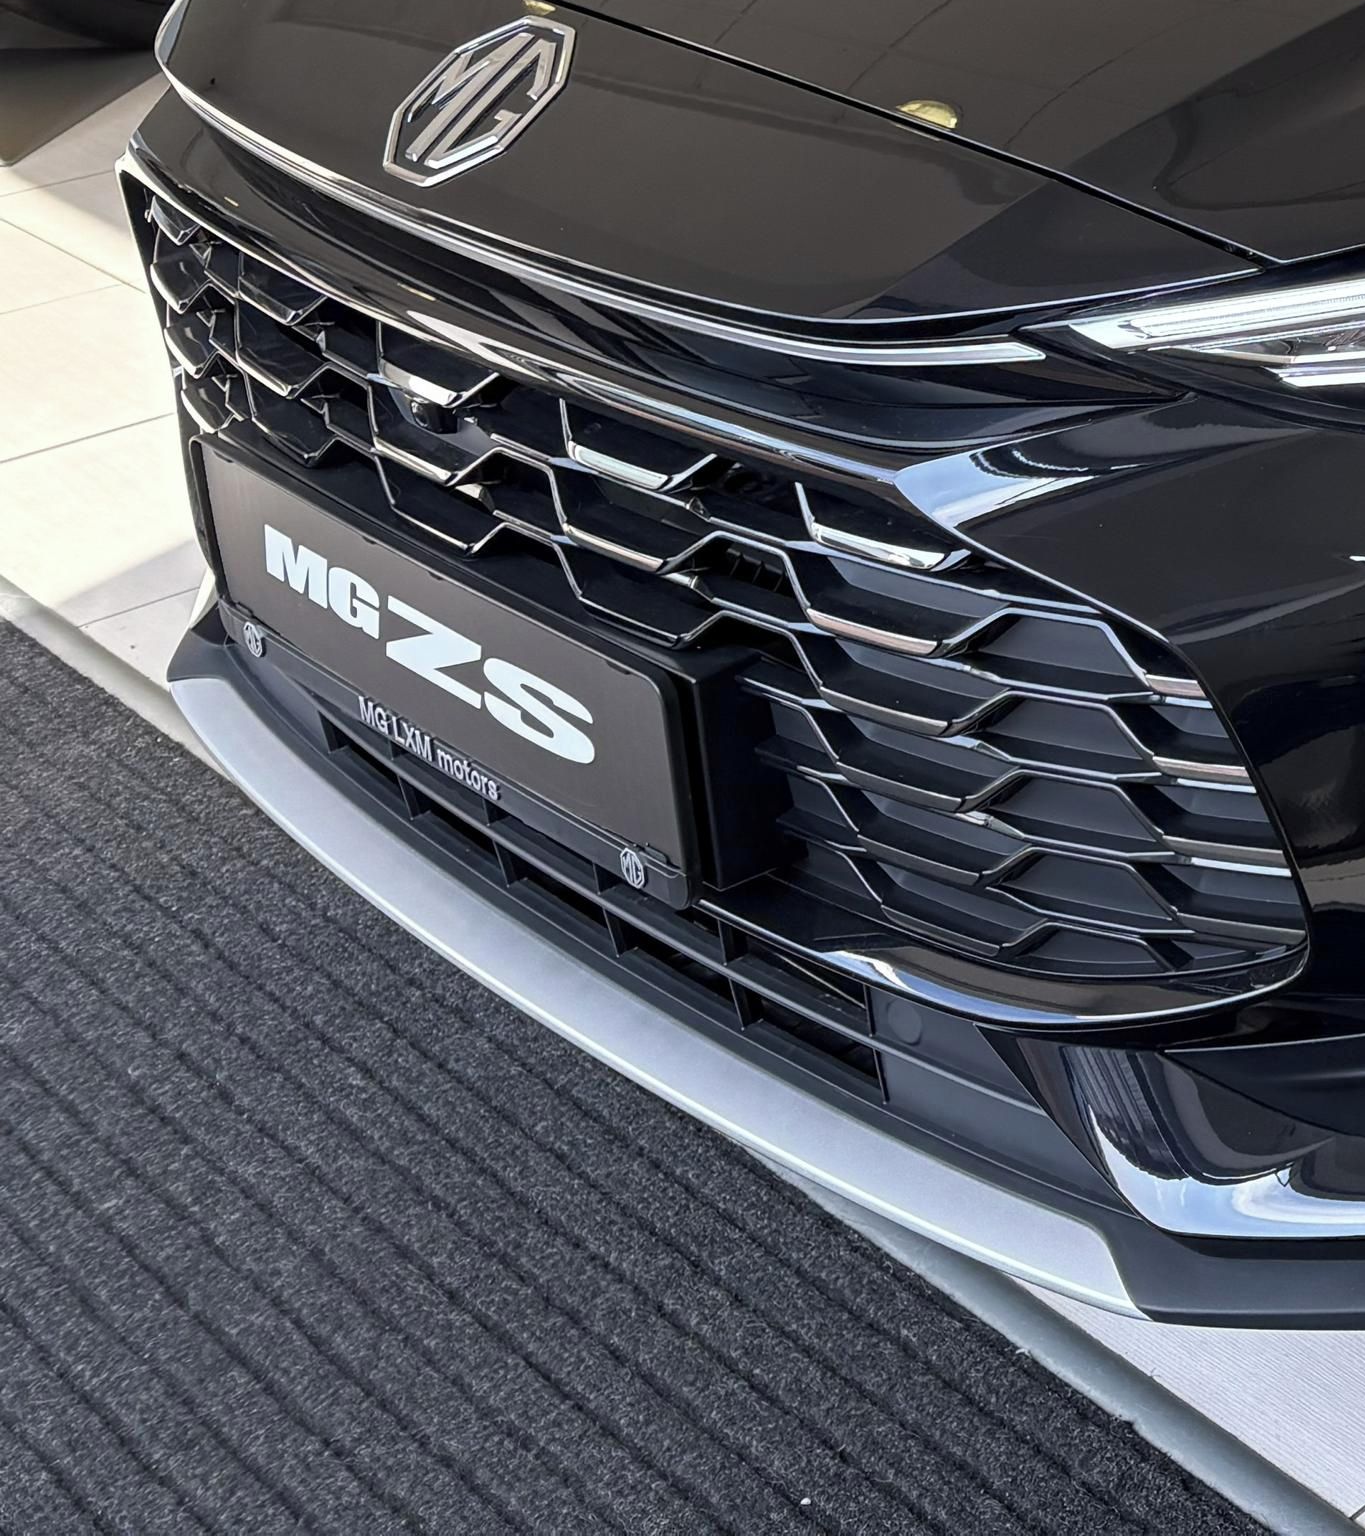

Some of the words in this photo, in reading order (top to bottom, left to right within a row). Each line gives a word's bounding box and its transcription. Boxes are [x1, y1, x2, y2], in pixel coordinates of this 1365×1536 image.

[396, 25, 564, 175] MG
[264, 523, 380, 639] MG
[386, 595, 595, 764] ZS
[358, 695, 389, 736] MG
[392, 716, 433, 762] LXM
[436, 748, 500, 801] motors
[621, 849, 644, 888] MG
